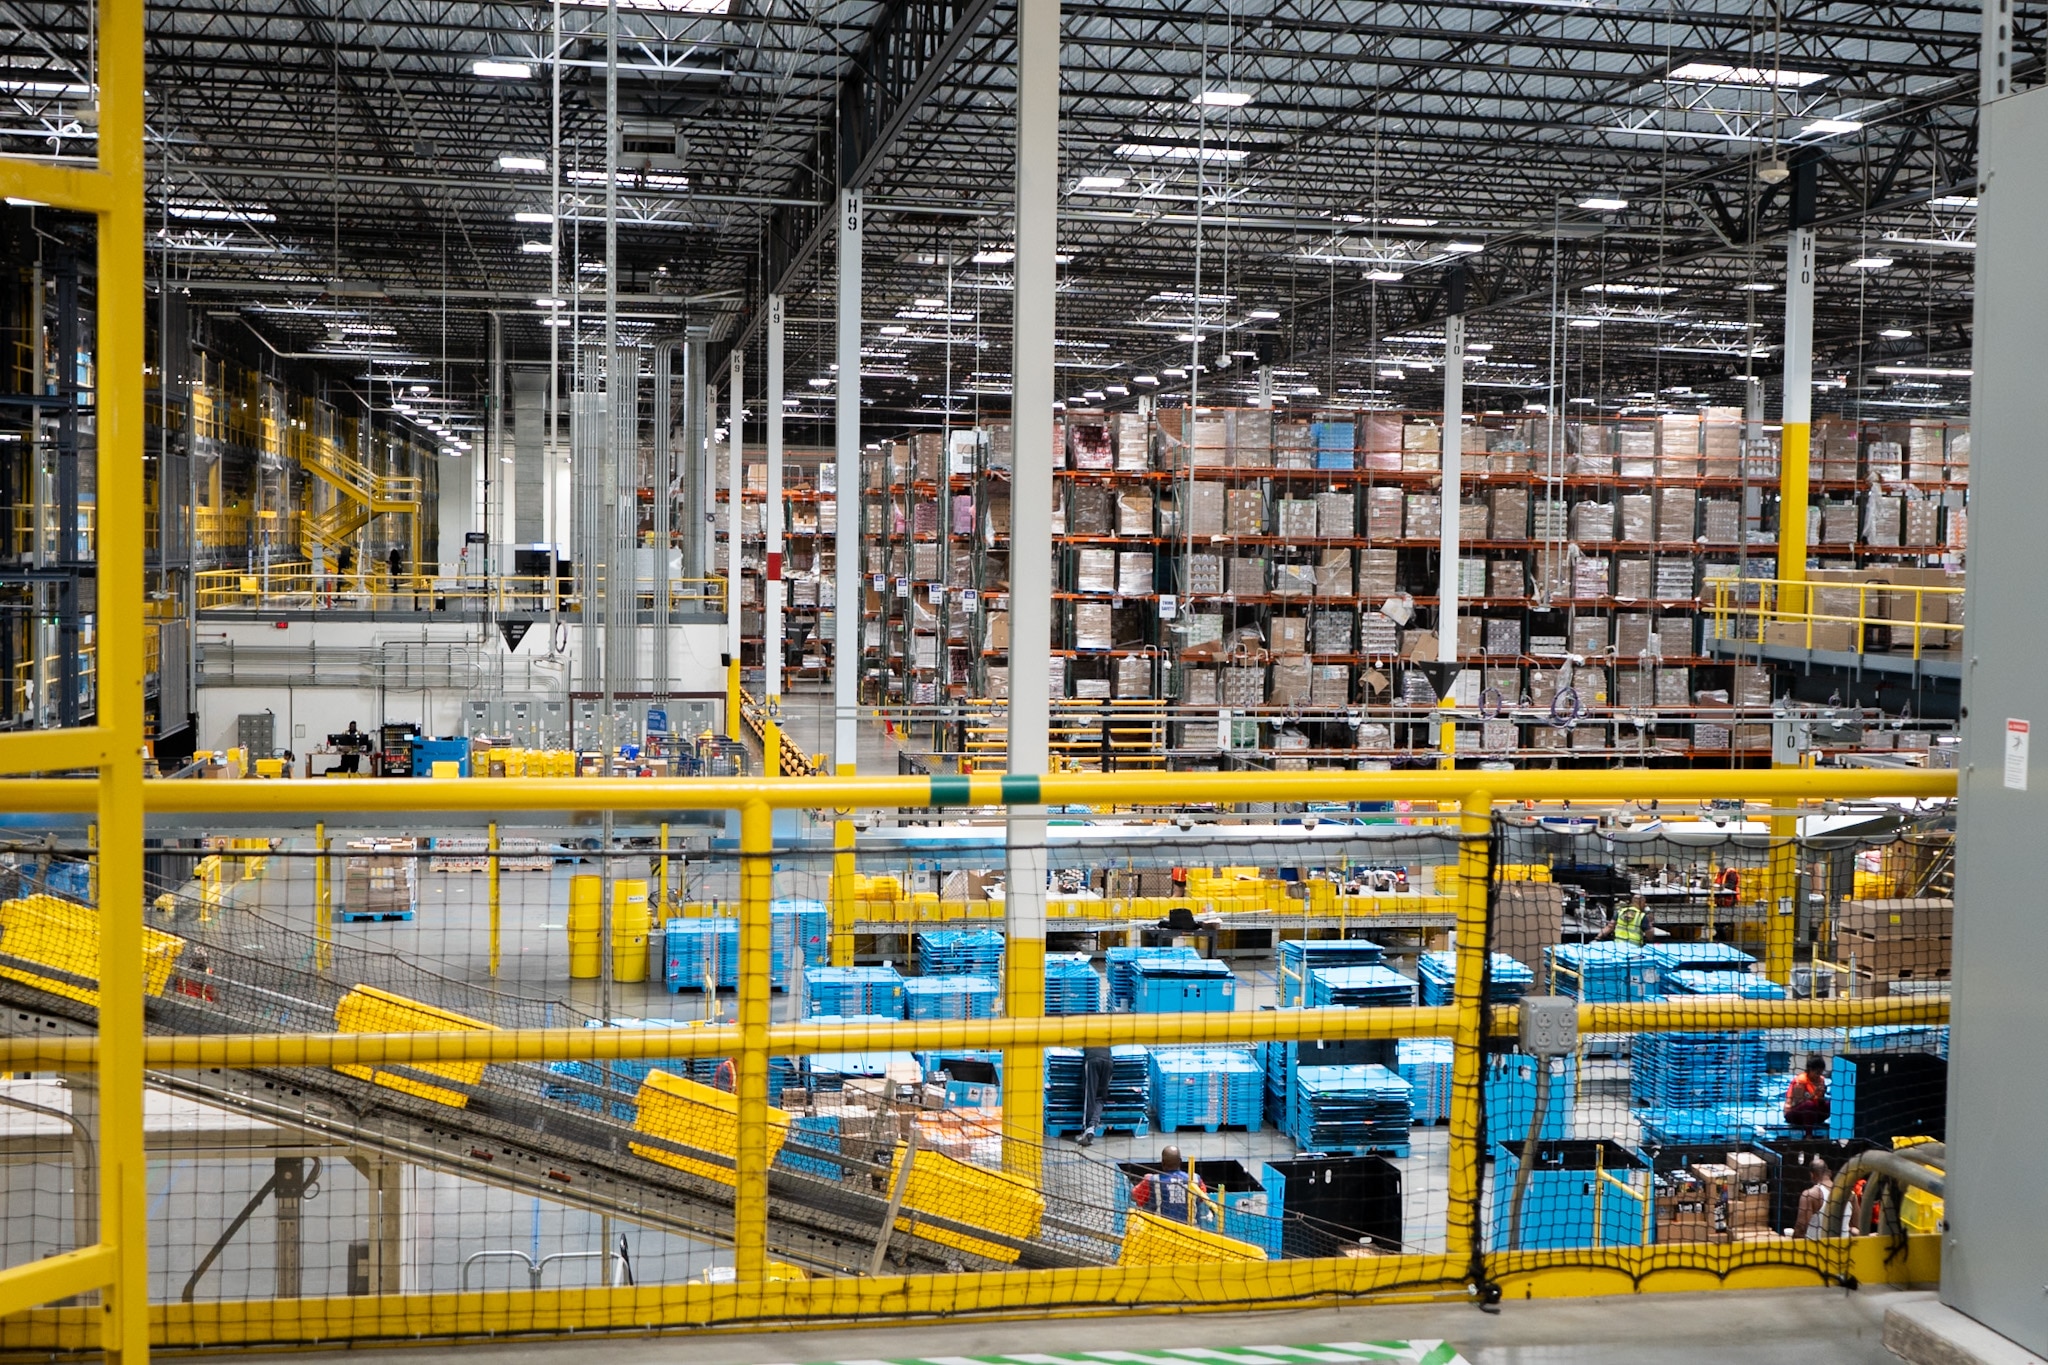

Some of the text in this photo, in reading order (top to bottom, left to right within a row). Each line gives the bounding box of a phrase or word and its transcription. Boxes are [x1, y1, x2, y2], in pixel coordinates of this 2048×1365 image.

[847, 198, 858, 231] H9
[1800, 236, 1811, 285] H10
[773, 300, 781, 324] J9
[1453, 321, 1461, 355] J10
